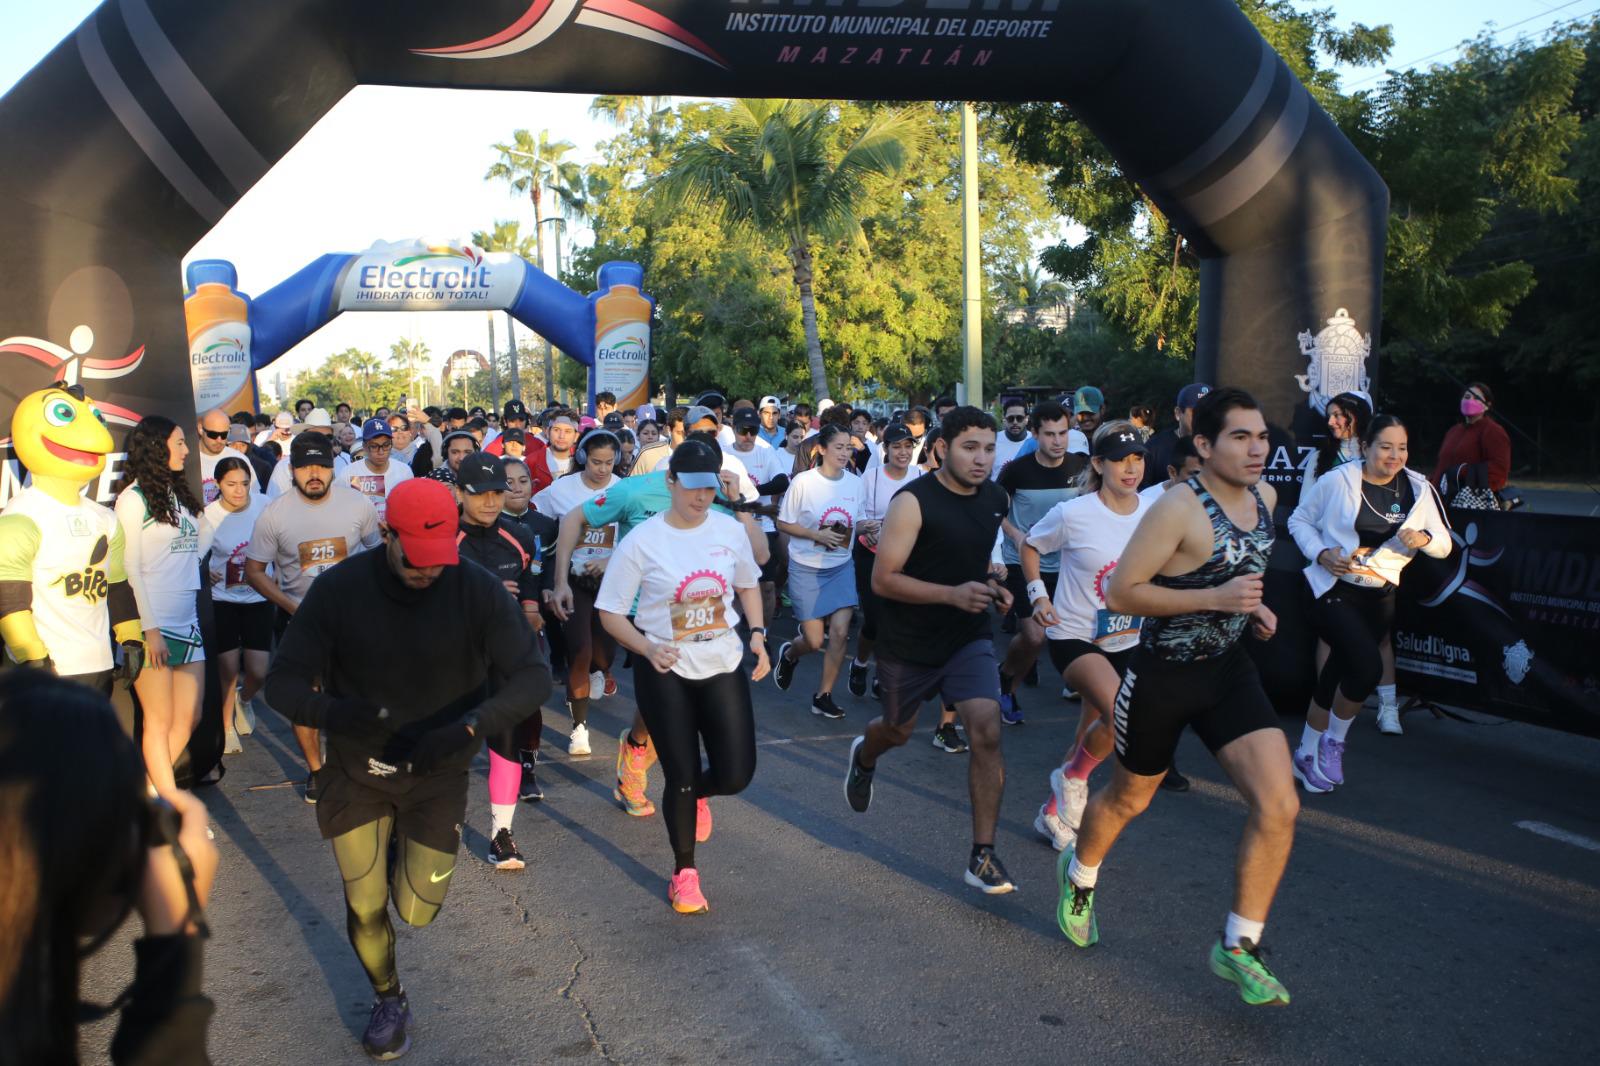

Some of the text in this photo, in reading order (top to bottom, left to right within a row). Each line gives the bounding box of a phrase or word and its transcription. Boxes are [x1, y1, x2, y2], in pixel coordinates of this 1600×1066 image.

[725, 12, 1052, 39] INSTITUTO MUNICIPAL DEL DEPORTE
[777, 44, 992, 67] MAZATLÁN
[359, 265, 492, 289] Electrolit
[356, 289, 489, 300] ¡HIDRATACIÓN TOTAL!
[192, 351, 246, 365] Electrolit
[599, 348, 647, 361] Electrolit
[584, 531, 606, 544] 201
[311, 545, 335, 561] 215
[685, 606, 715, 628] 293
[1107, 615, 1133, 633] 309
